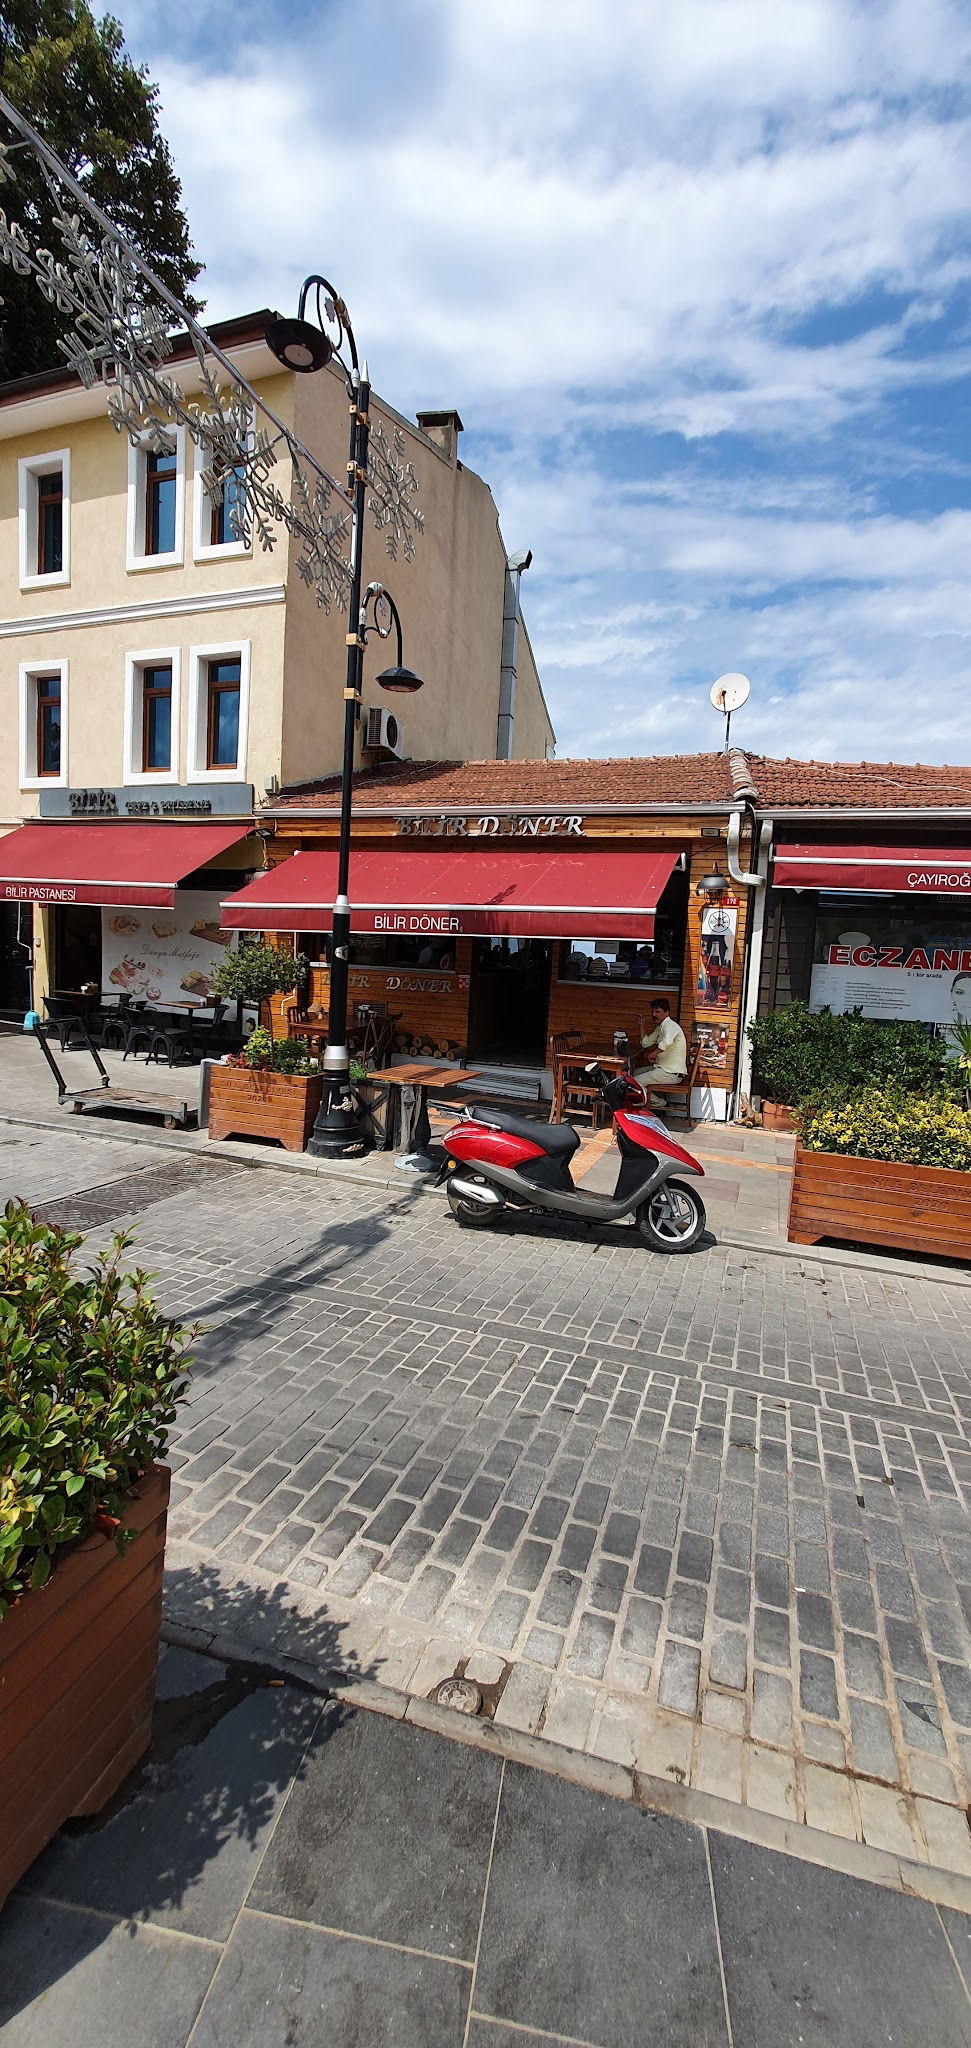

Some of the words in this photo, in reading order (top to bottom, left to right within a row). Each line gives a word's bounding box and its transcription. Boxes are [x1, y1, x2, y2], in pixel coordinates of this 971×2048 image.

[393, 815, 469, 837] BİLİR
[477, 815, 587, 837] DÖNER
[5, 885, 27, 898] BİLİR
[29, 887, 76, 900] PASTANESİ
[374, 913, 406, 929] BİLİR
[410, 914, 459, 931] DÖNER
[386, 976, 453, 993] DÖNER
